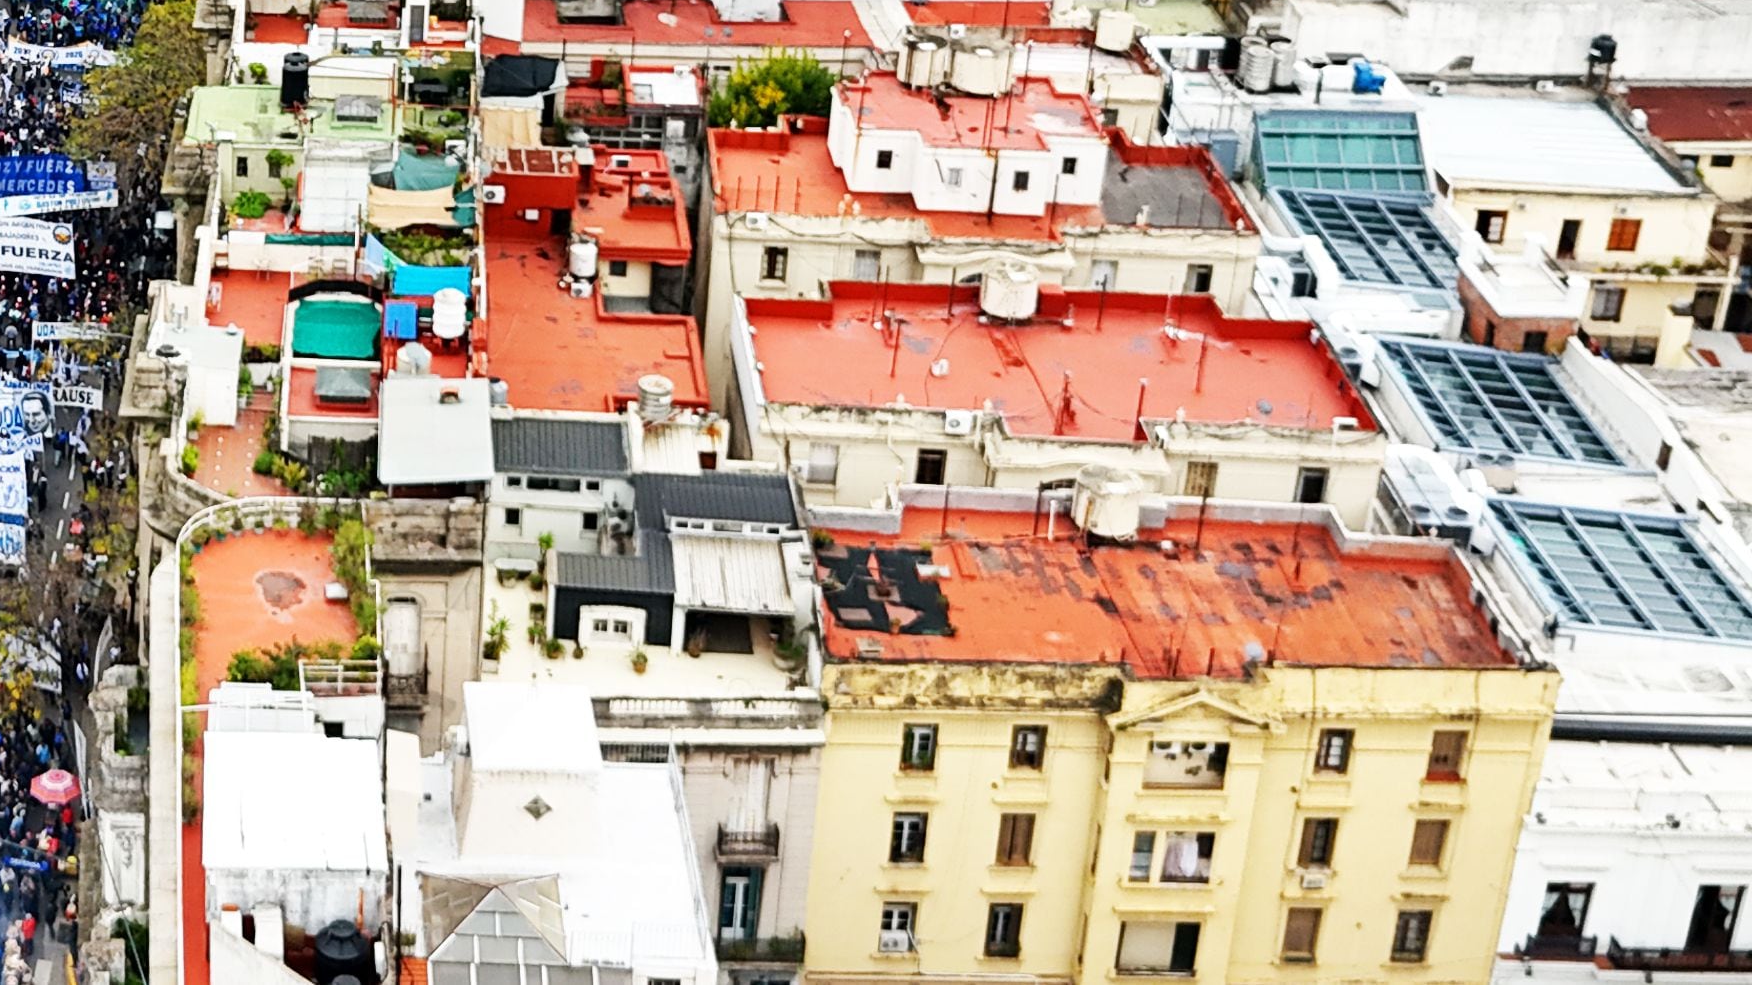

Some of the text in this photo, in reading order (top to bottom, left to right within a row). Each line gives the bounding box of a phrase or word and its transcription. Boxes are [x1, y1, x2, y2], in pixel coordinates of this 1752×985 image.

[14, 160, 23, 173] Y
[26, 158, 84, 175] FUERZA
[1, 245, 74, 263] FUERZA
